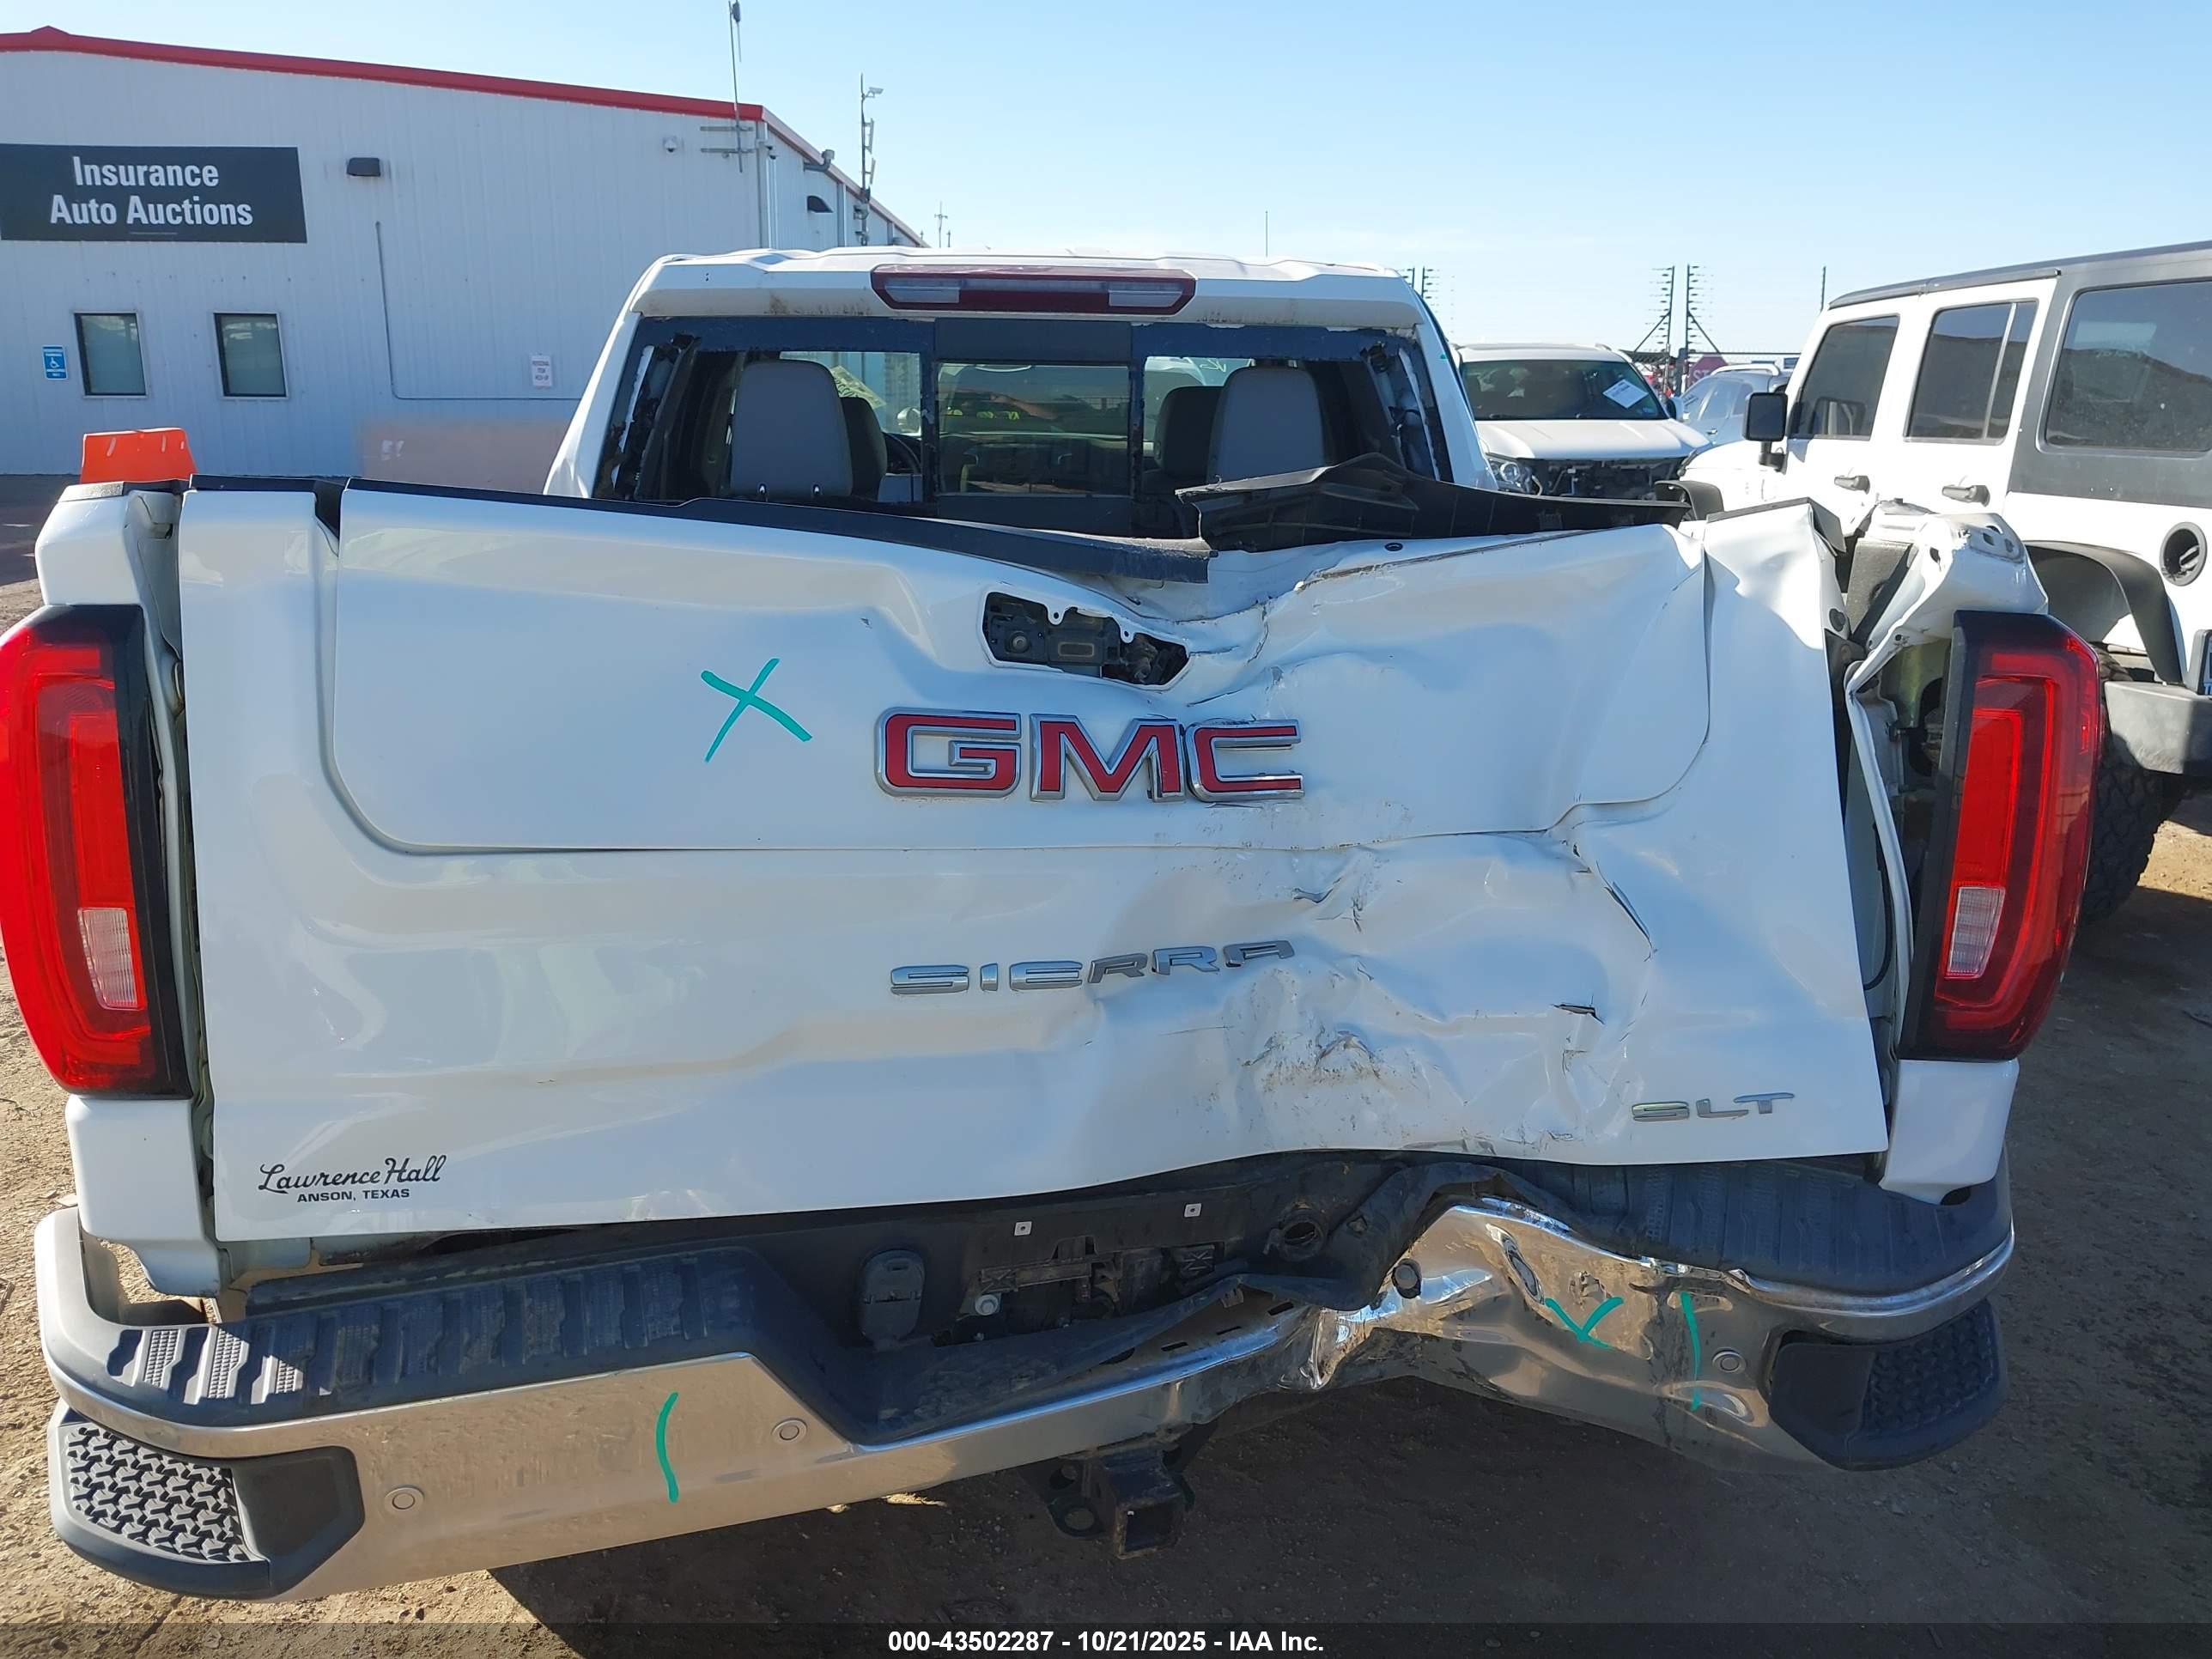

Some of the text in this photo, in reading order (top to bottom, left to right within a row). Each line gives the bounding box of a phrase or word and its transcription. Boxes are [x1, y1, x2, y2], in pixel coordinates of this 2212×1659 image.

[73, 156, 219, 187] Insurance
[50, 194, 253, 226] Auto Auctions
[875, 707, 1305, 803] GMC
[890, 939, 1295, 996] SIERRA
[1632, 1092, 1796, 1122] SLT
[258, 1154, 447, 1194] Lawrence Hall
[297, 1188, 410, 1203] ANSON, TEXAS
